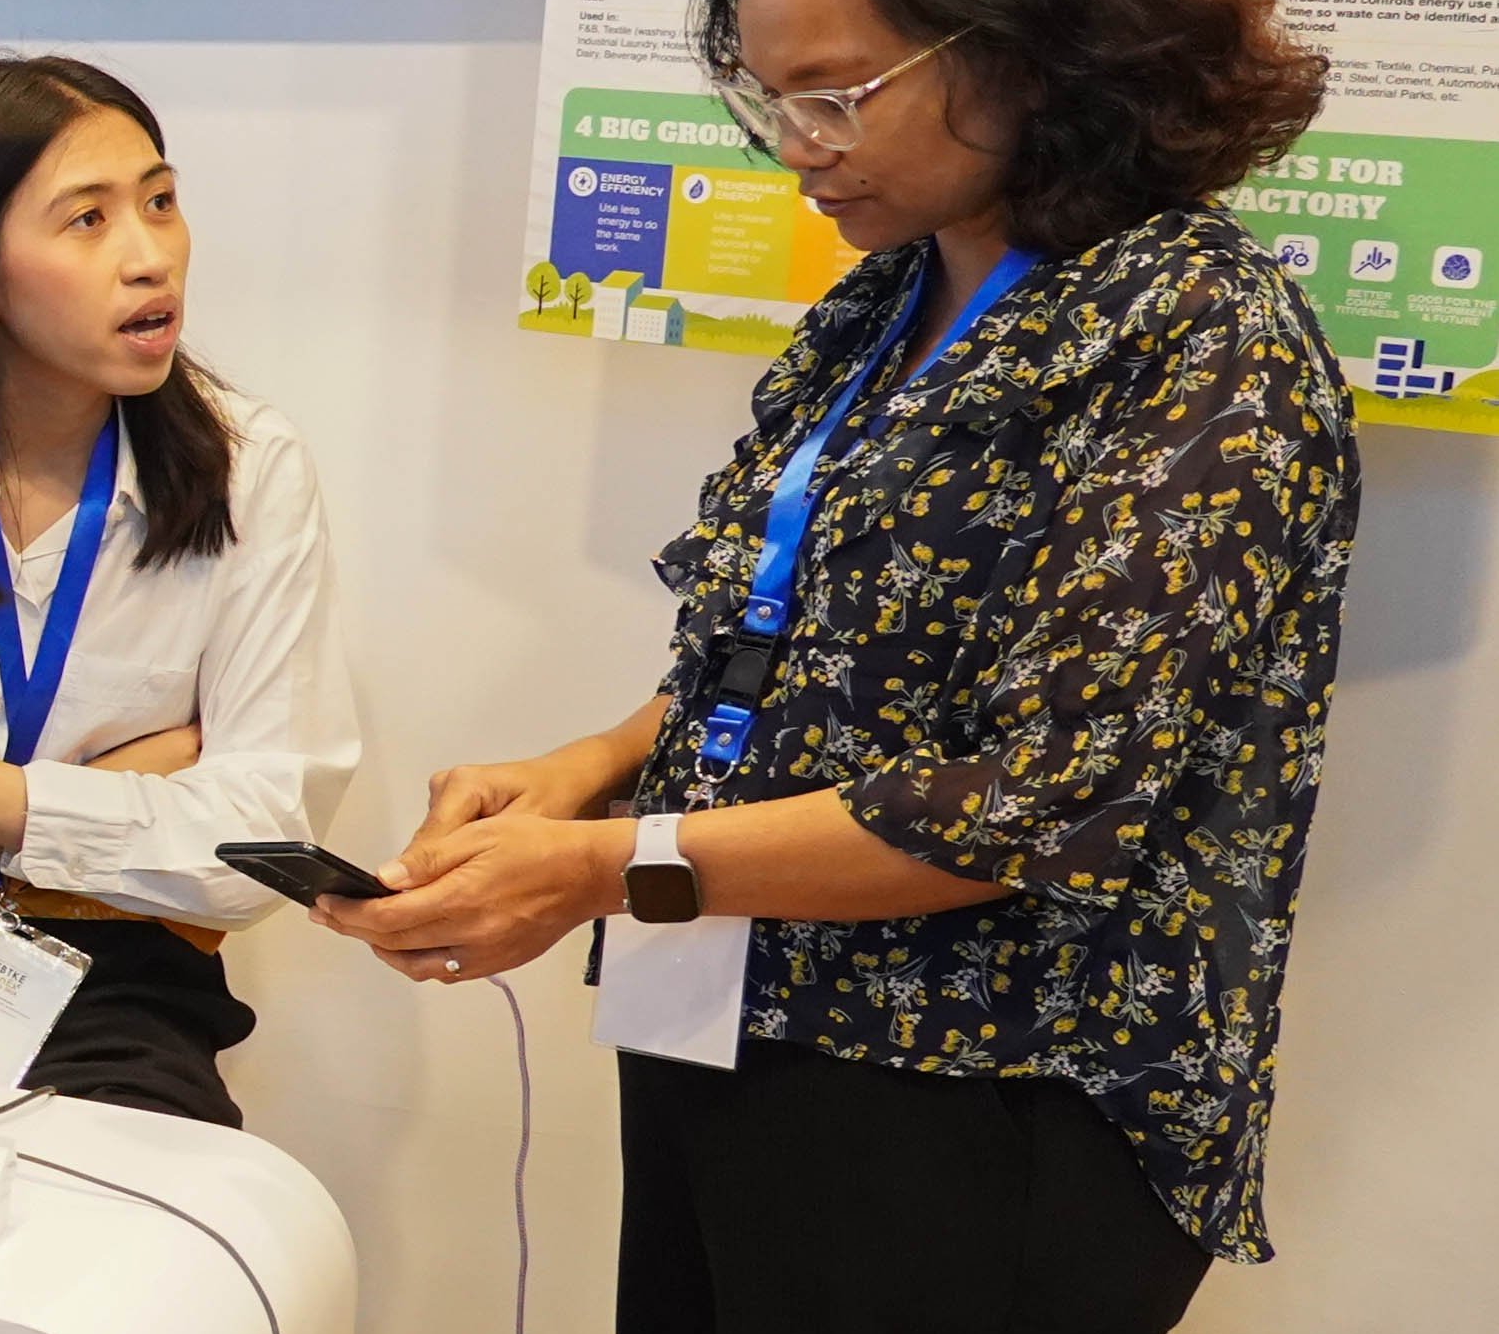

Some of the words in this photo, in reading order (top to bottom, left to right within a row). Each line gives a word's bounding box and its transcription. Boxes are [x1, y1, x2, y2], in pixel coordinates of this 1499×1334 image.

[1418, 0, 1464, 10] energy
[574, 115, 593, 137] 4
[599, 116, 650, 140] BIG
[1328, 157, 1404, 186] FOR
[601, 173, 646, 184] ENERGY
[600, 183, 664, 196] EFFICIENCY
